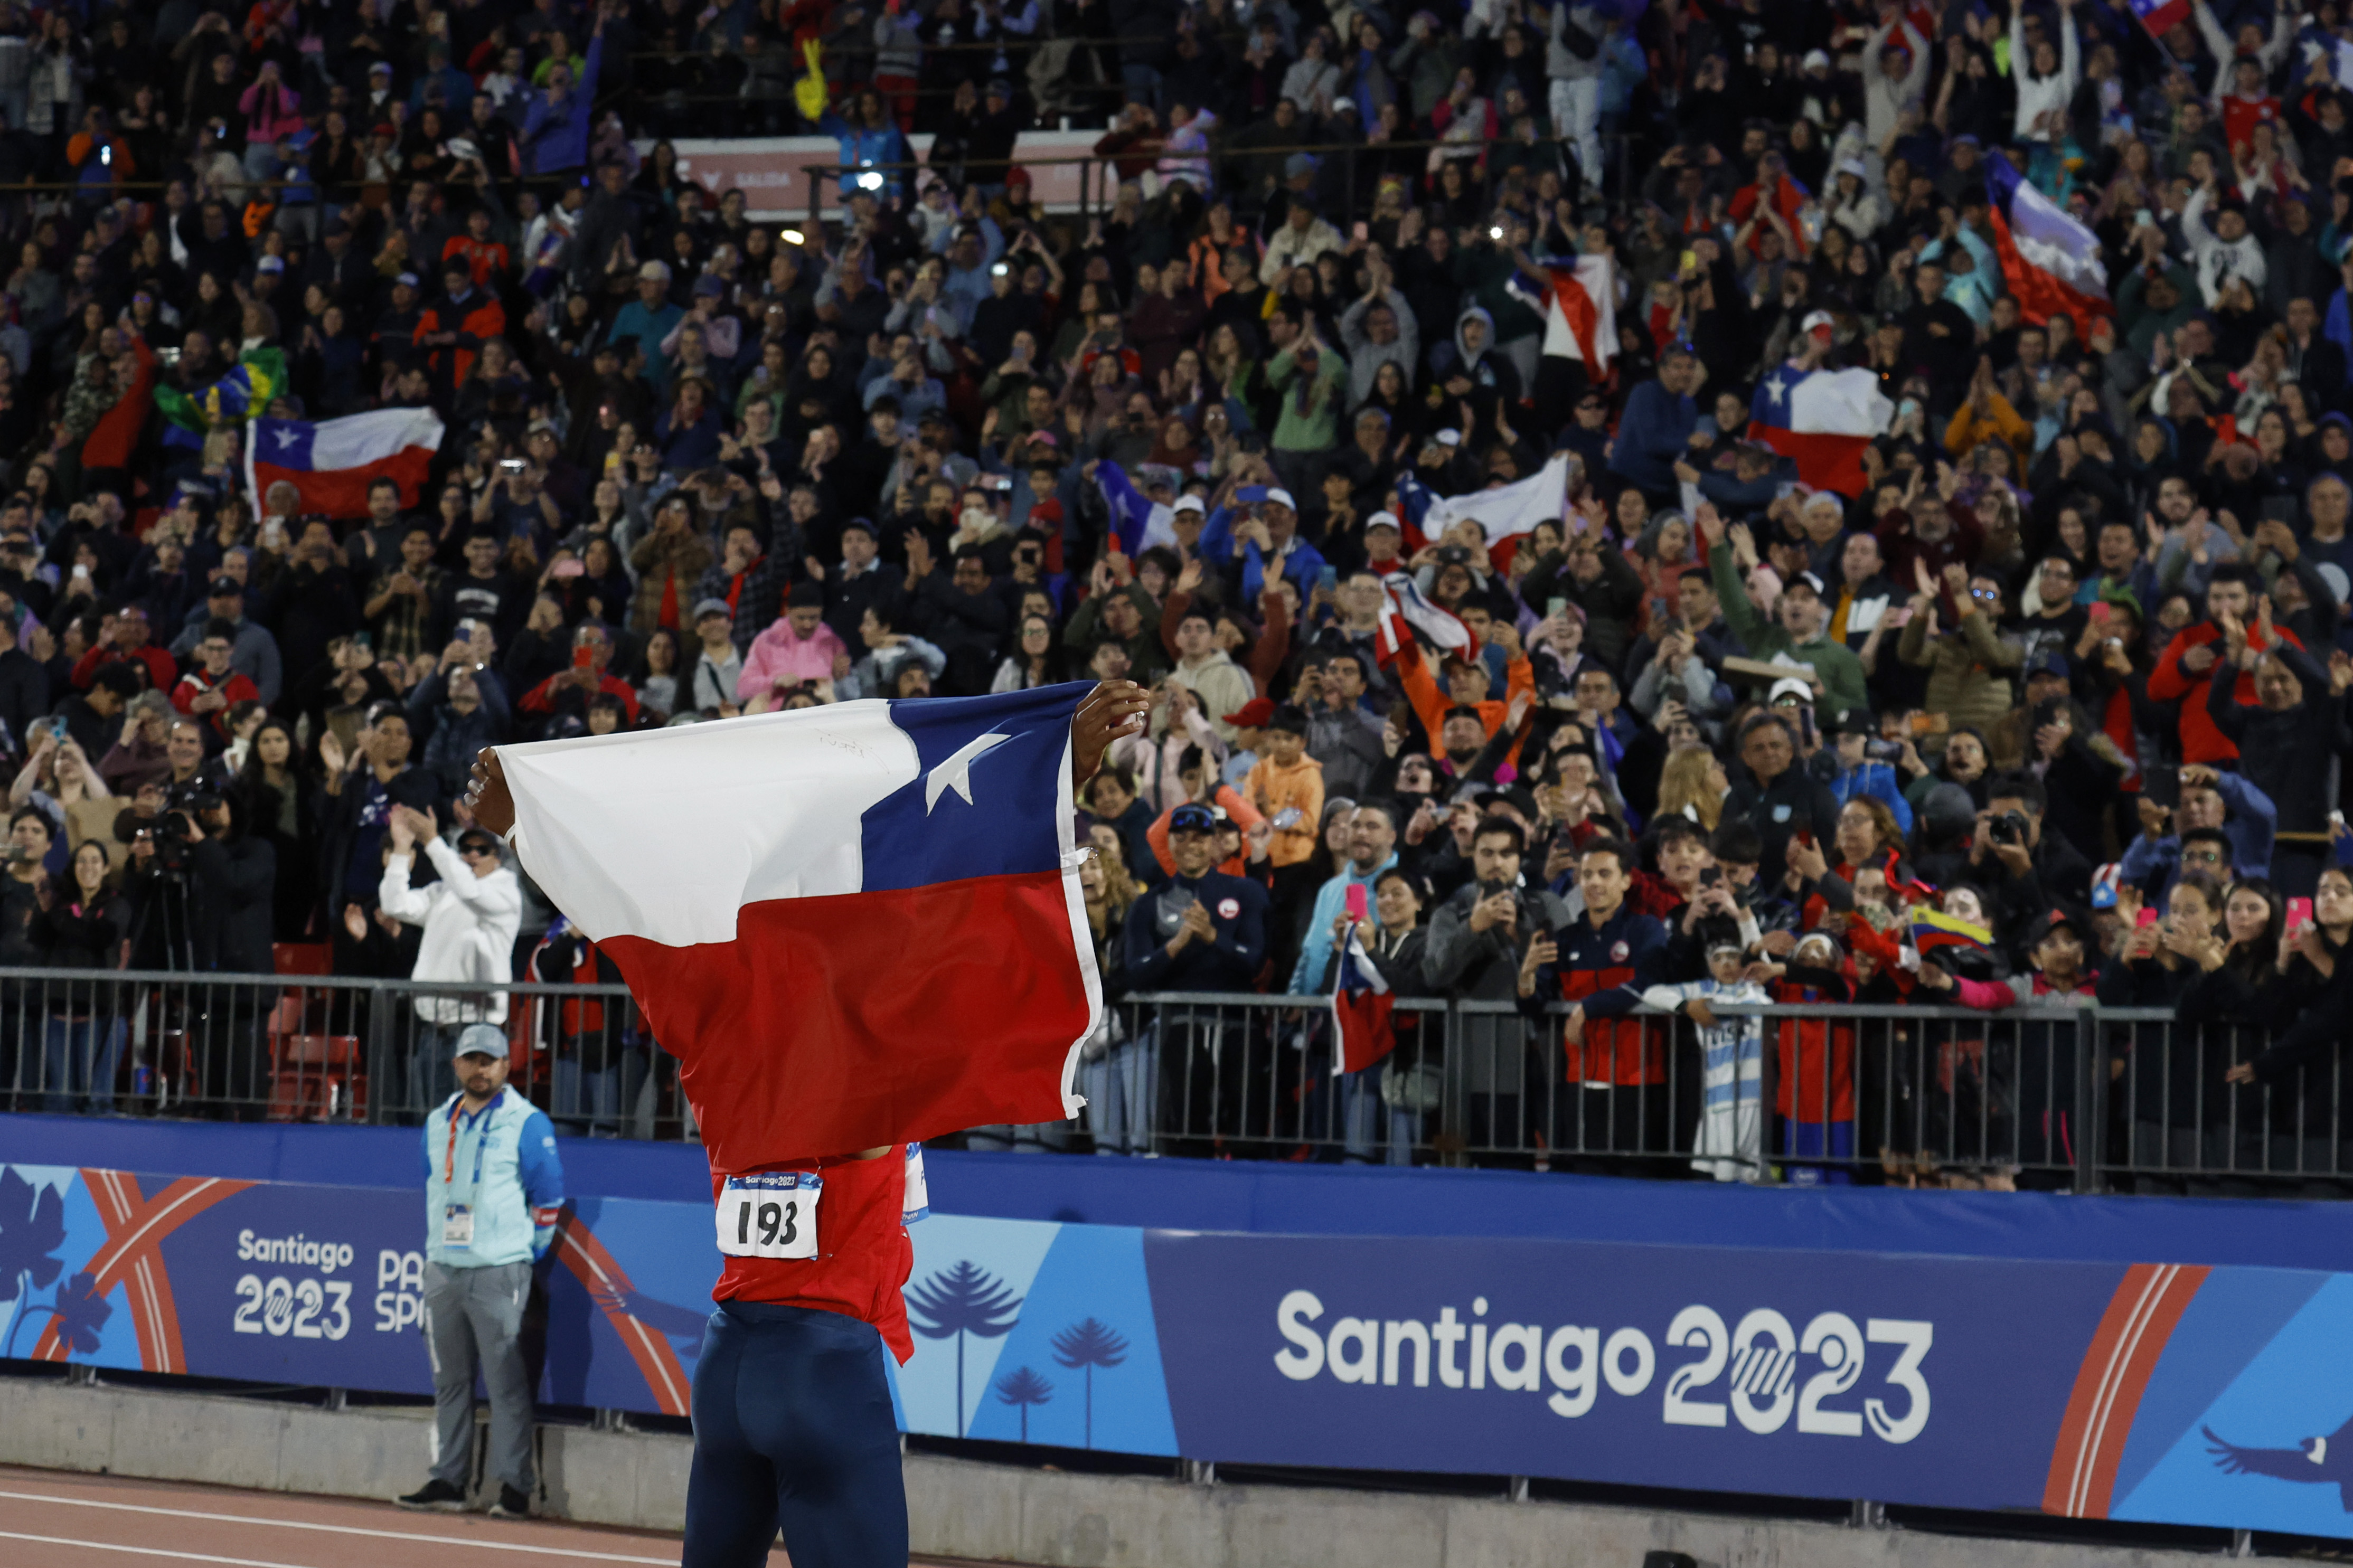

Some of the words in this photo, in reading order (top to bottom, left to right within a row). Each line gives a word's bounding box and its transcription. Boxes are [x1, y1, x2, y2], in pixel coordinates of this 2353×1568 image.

[745, 1176, 778, 1186] Saniago
[778, 1176, 796, 1186] 2023
[738, 1201, 797, 1246] 193
[238, 1229, 353, 1273] Santiago
[234, 1273, 352, 1340] 2023
[1274, 1290, 1655, 1418] Santiago
[1663, 1305, 1933, 1444] 2023
